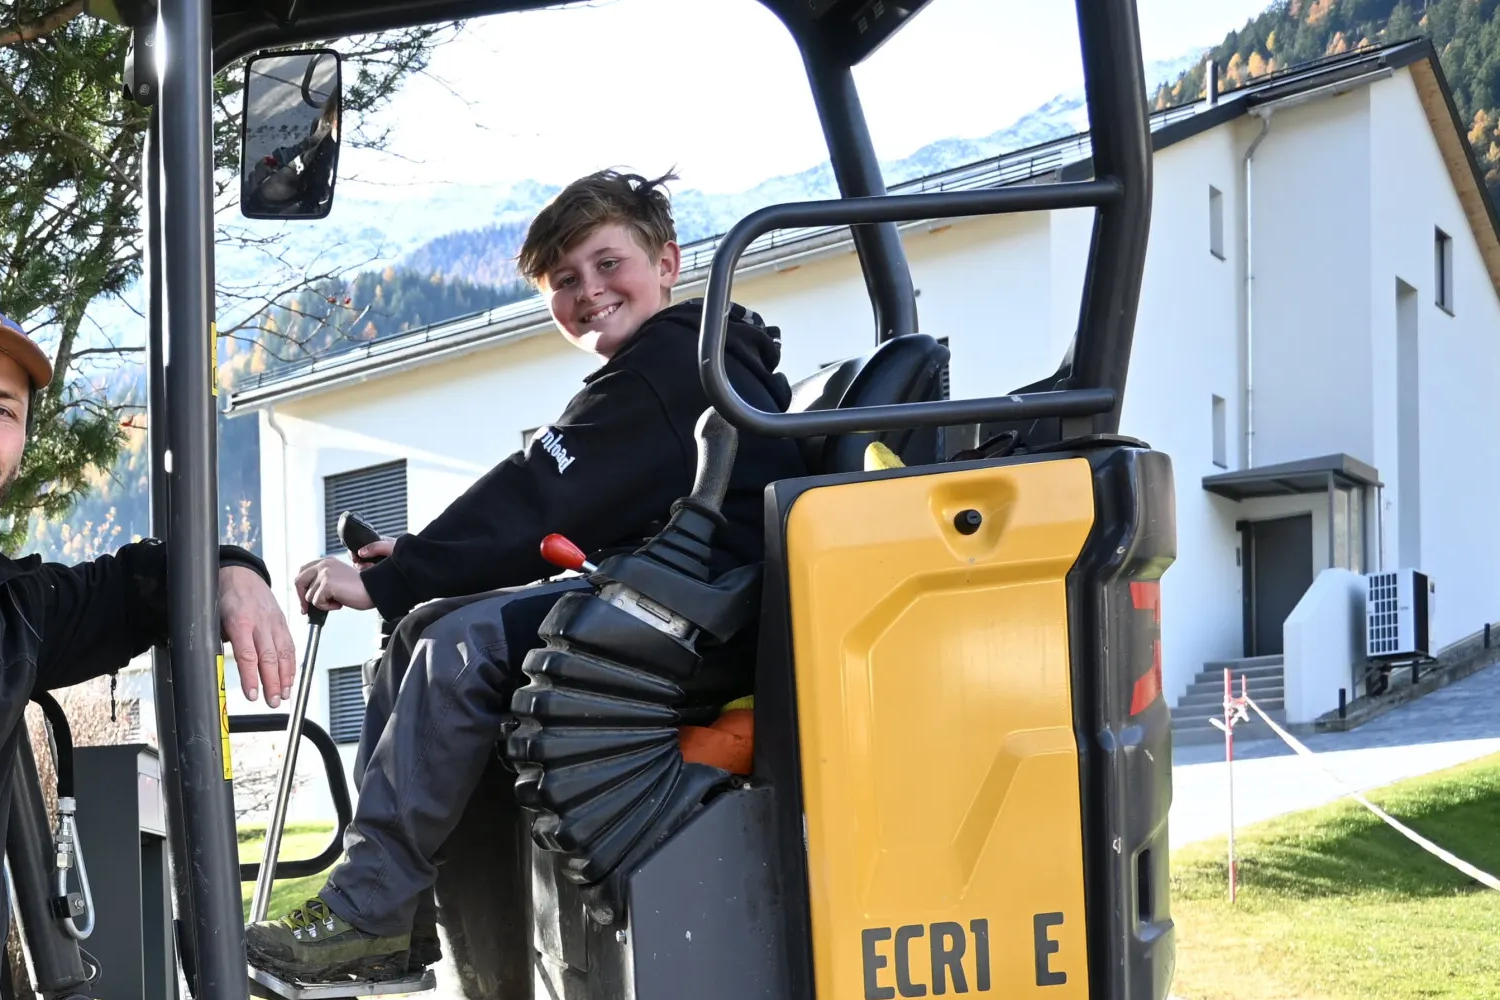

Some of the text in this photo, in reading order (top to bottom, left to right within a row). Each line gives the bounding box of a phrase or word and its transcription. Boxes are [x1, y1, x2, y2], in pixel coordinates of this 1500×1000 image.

[540, 432, 576, 474] nload
[861, 911, 1067, 1000] ECR1 E
